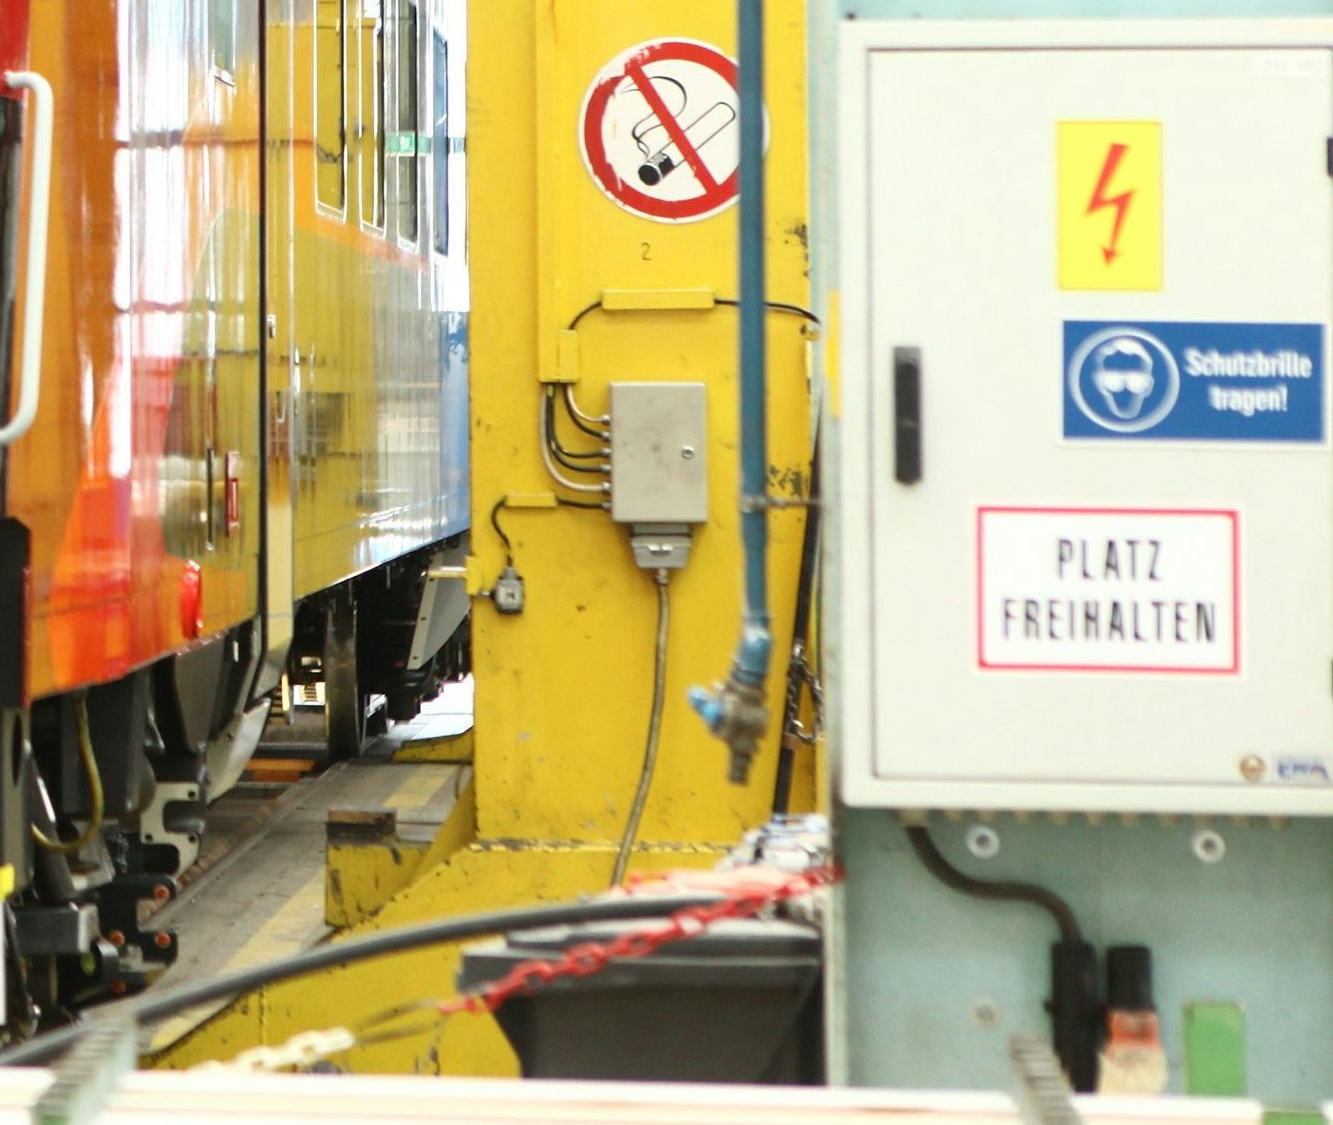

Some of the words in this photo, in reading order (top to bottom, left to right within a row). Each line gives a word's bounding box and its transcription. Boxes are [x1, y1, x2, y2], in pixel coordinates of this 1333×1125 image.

[641, 242, 652, 261] 2
[1185, 347, 1312, 378] Schutzbrille
[1209, 384, 1287, 416] tragen!
[1057, 538, 1161, 580] PLATZ
[1002, 598, 1215, 643] FREIHALTEN
